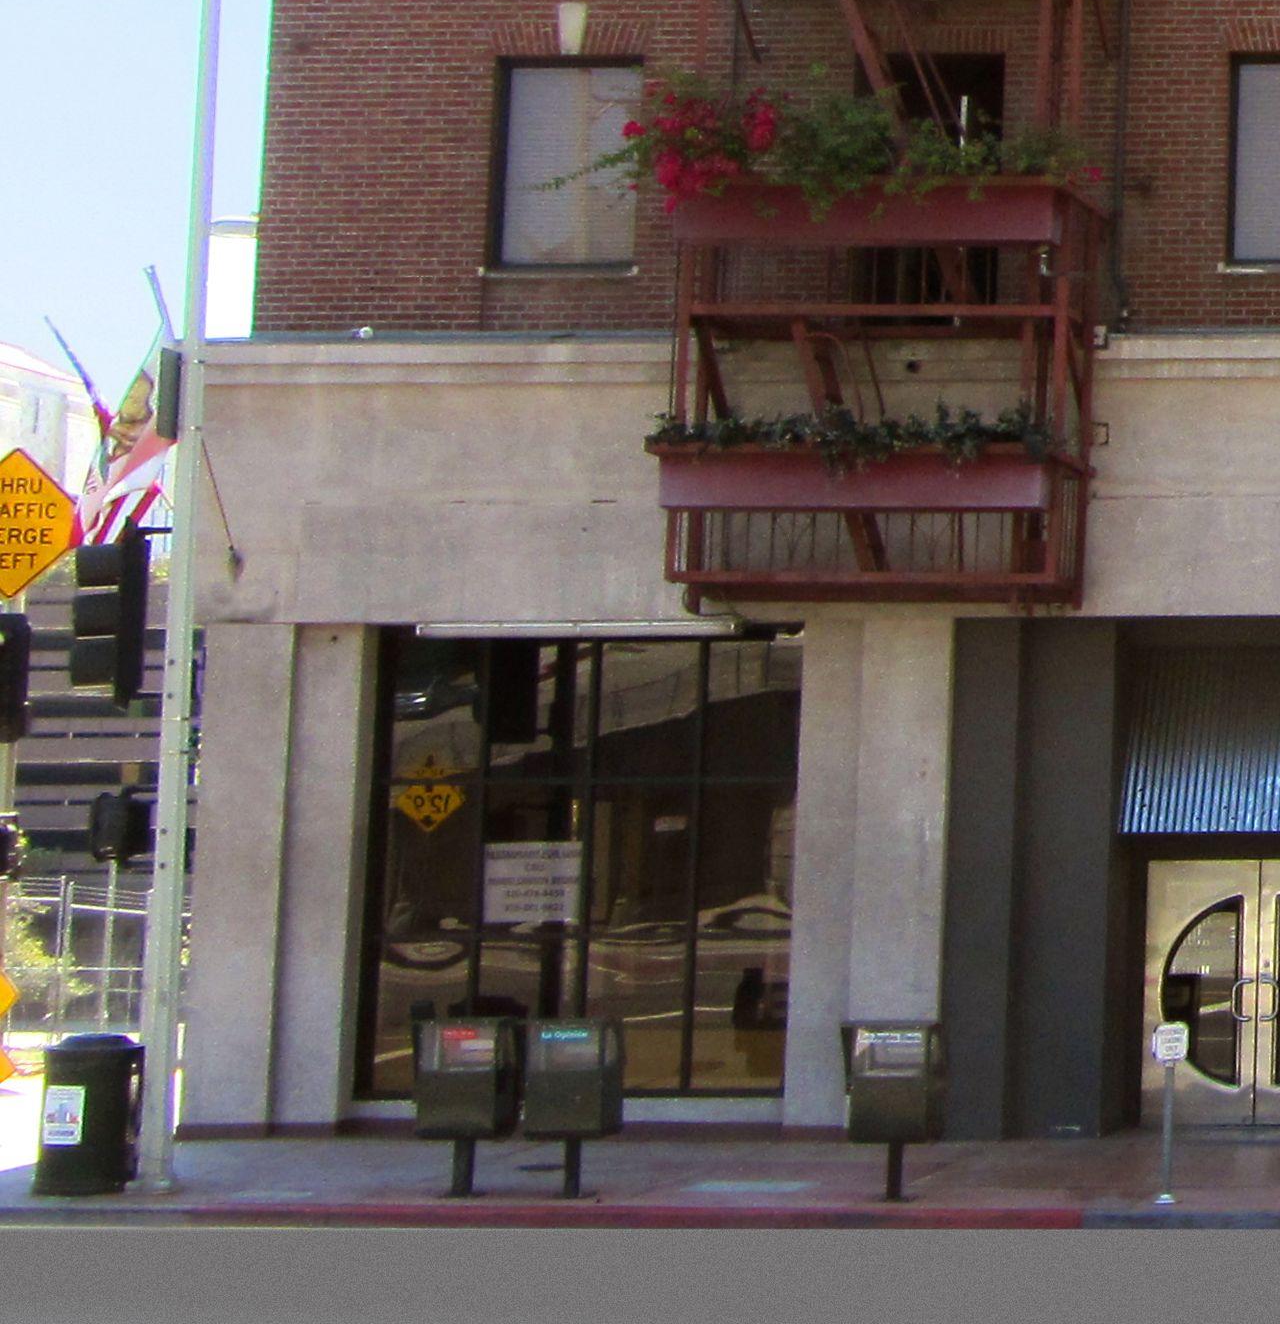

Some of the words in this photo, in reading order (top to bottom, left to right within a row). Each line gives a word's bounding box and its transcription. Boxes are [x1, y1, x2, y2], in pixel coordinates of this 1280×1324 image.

[0, 478, 43, 494] HRU
[0, 502, 57, 519] AFFIC
[0, 527, 53, 544] ERGE
[0, 552, 38, 569] EFT
